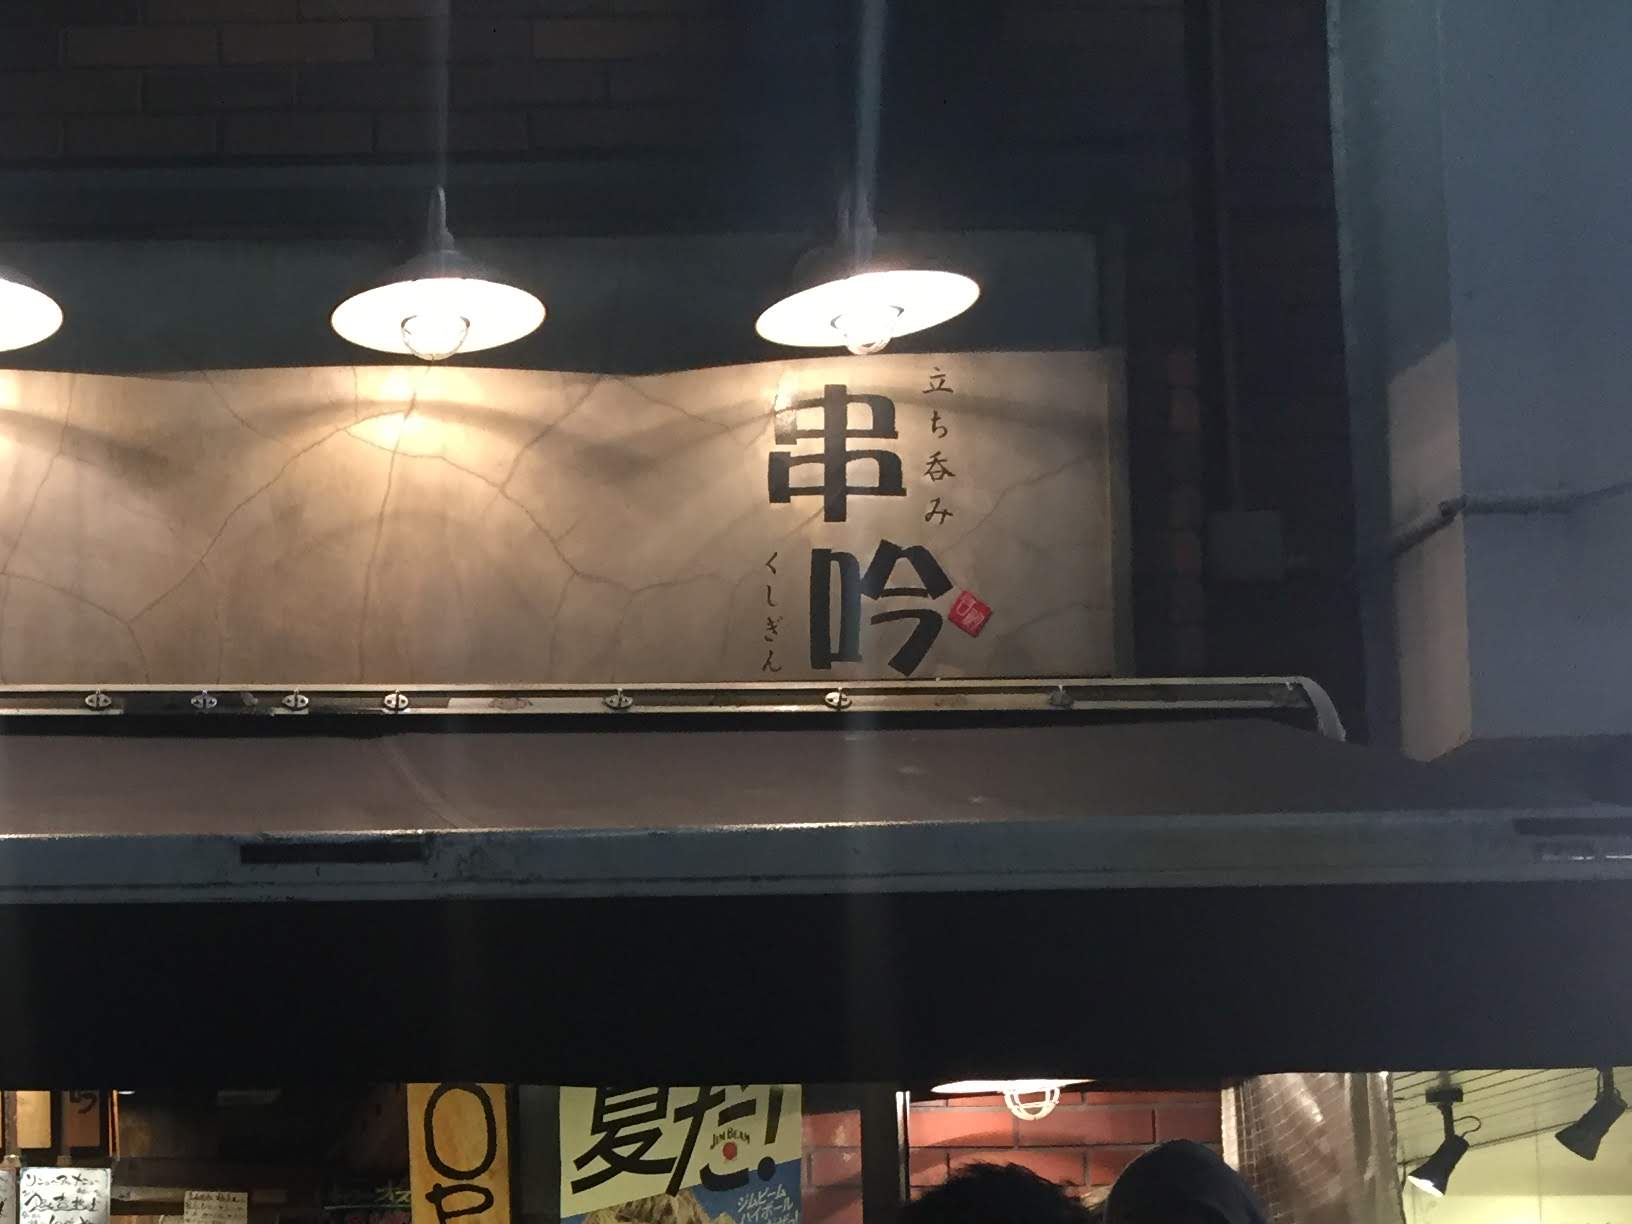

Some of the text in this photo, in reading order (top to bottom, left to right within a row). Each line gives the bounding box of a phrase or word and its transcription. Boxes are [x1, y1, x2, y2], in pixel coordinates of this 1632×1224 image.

[921, 367, 956, 525] 立ち呑み
[768, 384, 954, 677] 串吟
[761, 551, 784, 673] くしぎん
[727, 1128, 751, 1145] BEAM
[737, 1183, 787, 1213] ジムビーム
